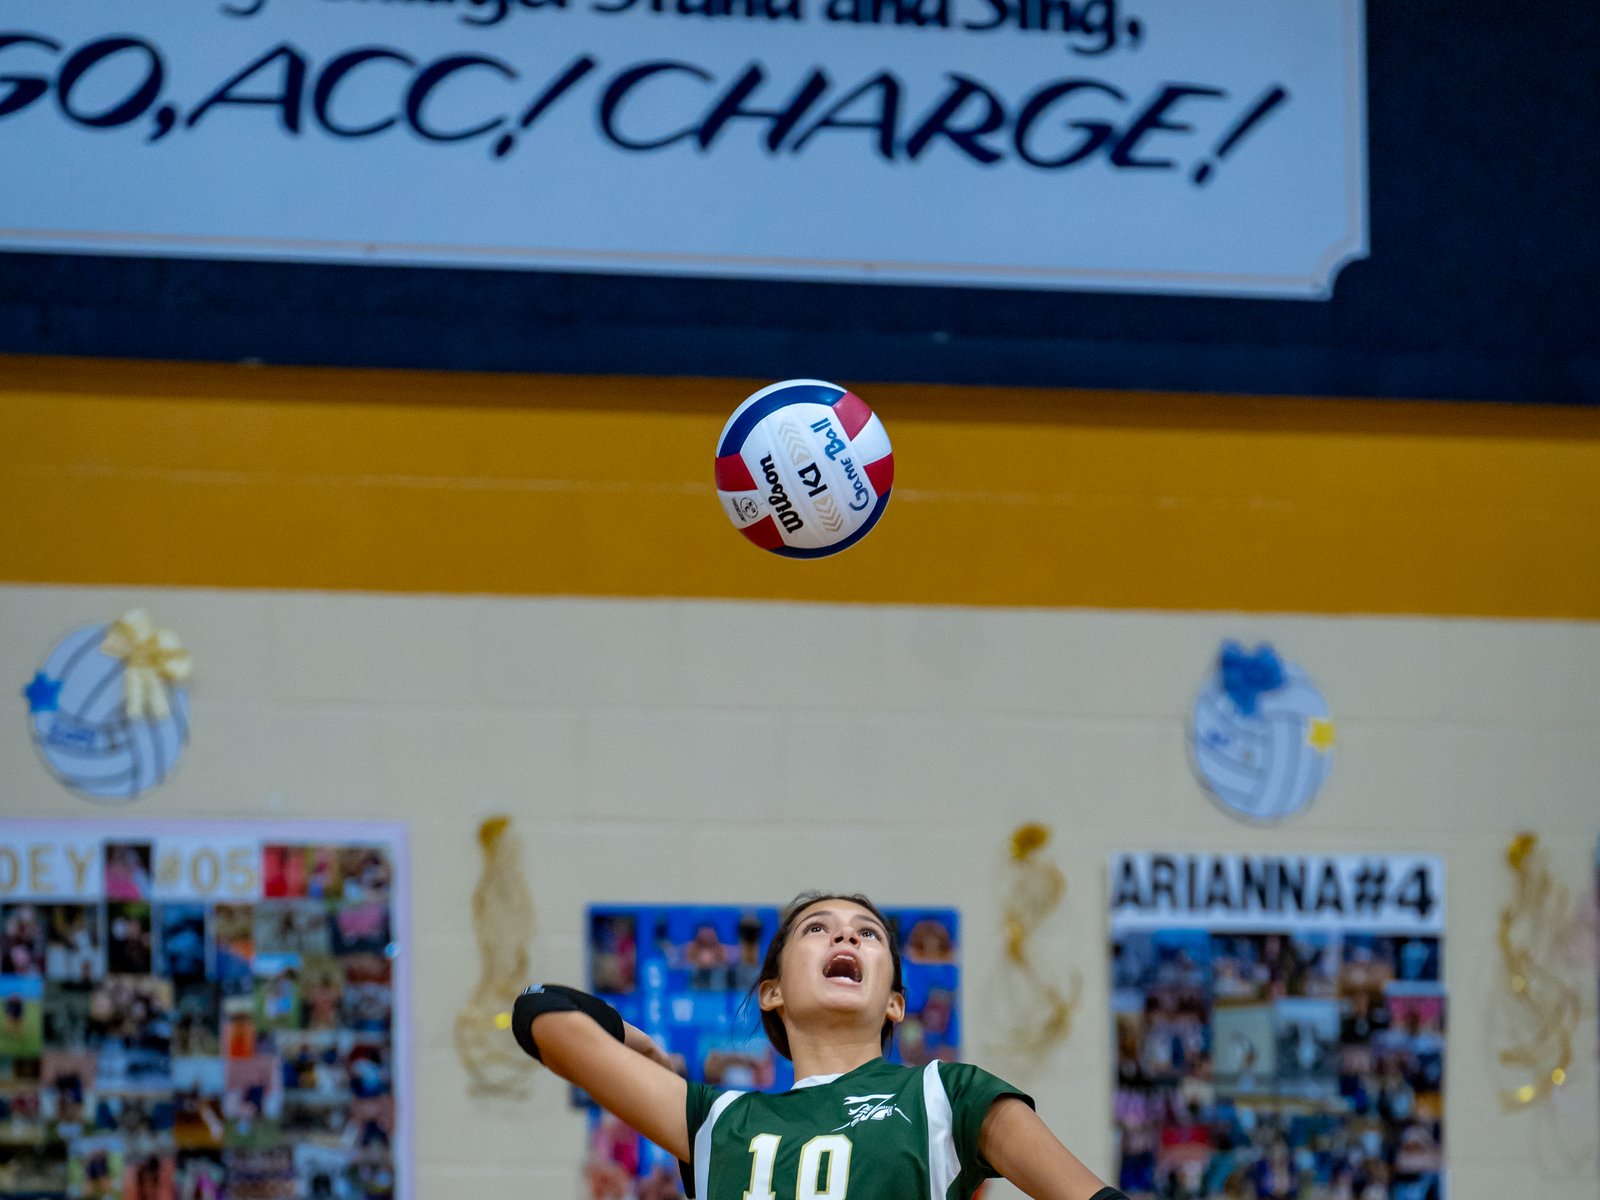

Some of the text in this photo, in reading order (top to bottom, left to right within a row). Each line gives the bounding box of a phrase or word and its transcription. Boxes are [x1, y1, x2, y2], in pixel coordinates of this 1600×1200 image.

[596, 60, 1290, 187] CHARGE!
[809, 417, 847, 462] Ball
[760, 452, 804, 535] Wilson
[797, 462, 828, 498] K1
